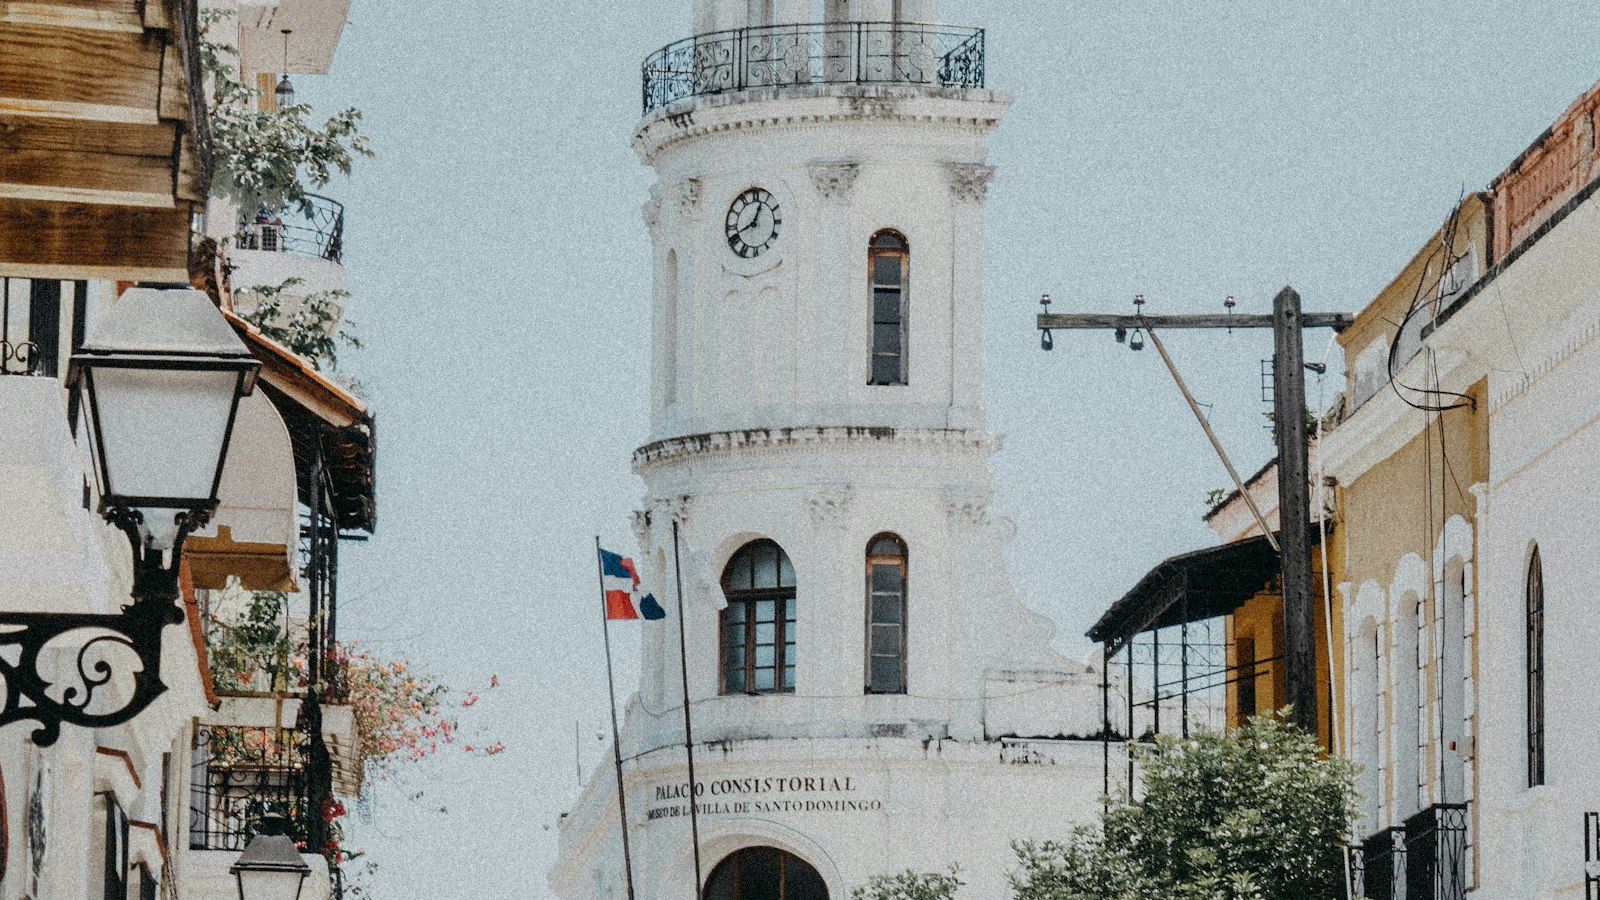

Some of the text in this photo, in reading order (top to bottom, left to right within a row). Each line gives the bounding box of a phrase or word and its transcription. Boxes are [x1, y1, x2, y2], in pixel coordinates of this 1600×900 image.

[656, 777, 856, 800] PALACO CONSISTORIAL
[695, 803, 730, 815] VILLA
[734, 802, 750, 813] DE
[755, 801, 803, 813] SANTO
[806, 800, 881, 812] DOMINGO
